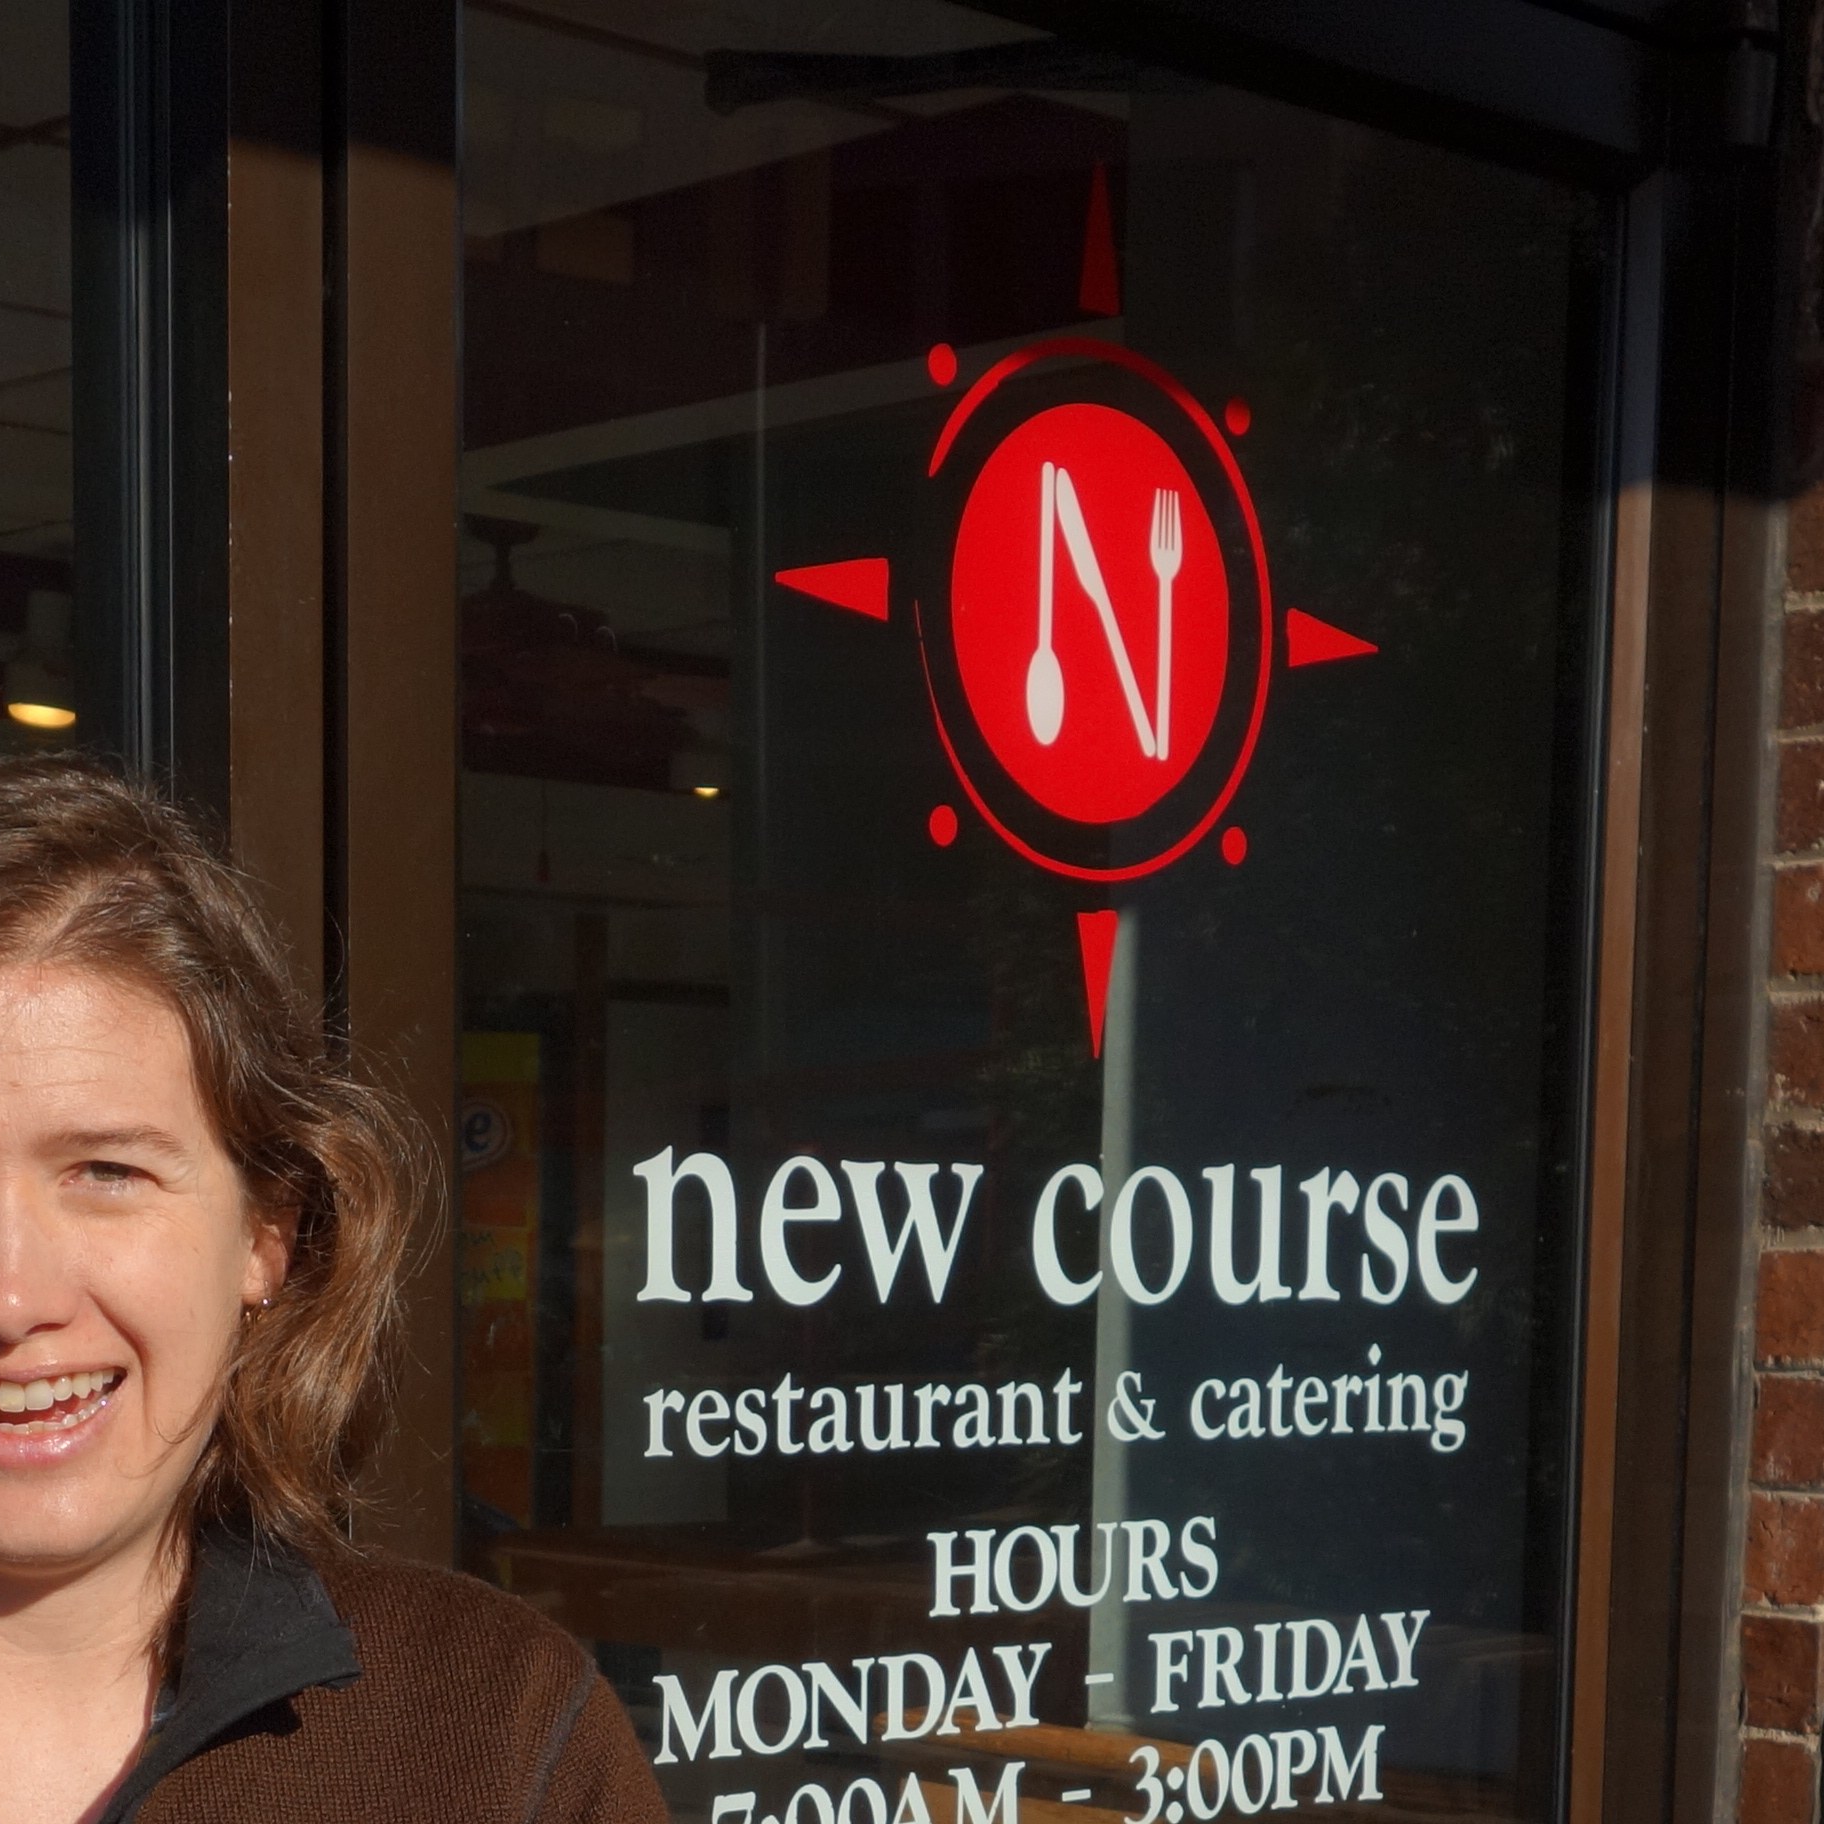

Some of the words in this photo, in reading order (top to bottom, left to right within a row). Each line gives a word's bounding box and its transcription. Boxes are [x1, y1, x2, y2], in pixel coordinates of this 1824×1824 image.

[633, 1144, 985, 1307] new
[1031, 1162, 1480, 1307] course
[643, 1366, 1084, 1459] restaurant
[1107, 1369, 1167, 1442] &
[1190, 1342, 1470, 1453] catering
[926, 1516, 1219, 1618] HOURS
[653, 1641, 1053, 1766] MONDAY
[1149, 1609, 1431, 1714] FRIDAY
